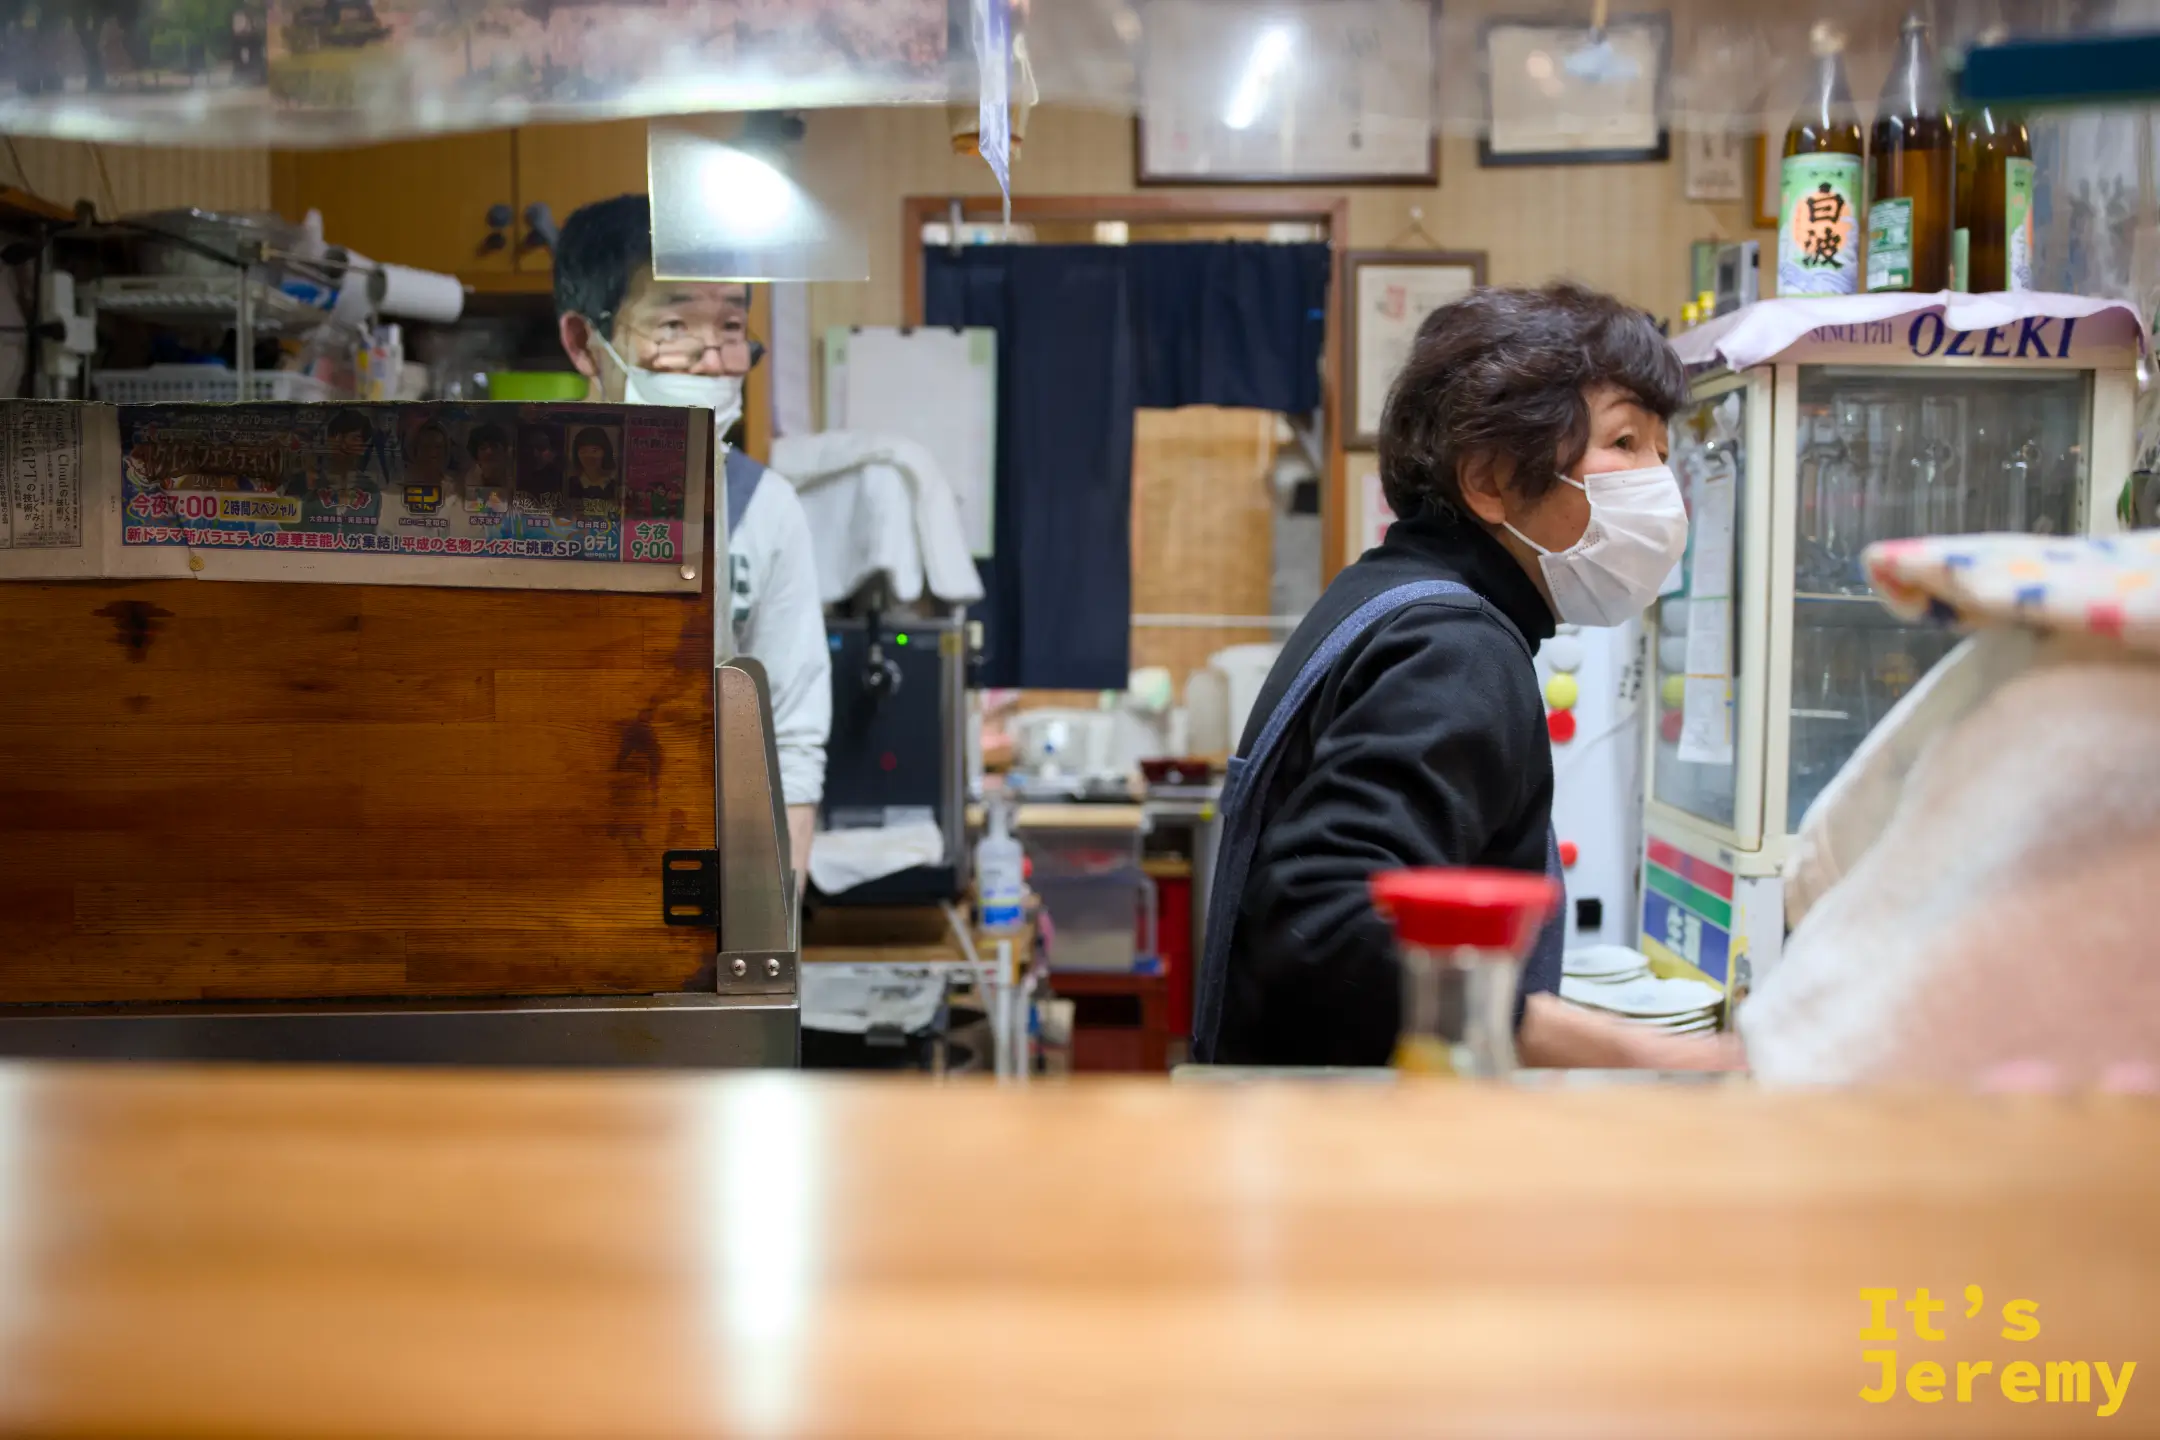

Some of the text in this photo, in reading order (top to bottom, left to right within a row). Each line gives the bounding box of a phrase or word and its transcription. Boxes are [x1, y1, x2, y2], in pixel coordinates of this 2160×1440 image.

[1803, 182, 1845, 269] 白波
[1908, 312, 2079, 359] OZEKI
[223, 500, 297, 517] 2時間スペシャル
[636, 523, 669, 540] 今夜
[584, 535, 618, 551] 日テレ
[631, 540, 674, 561] 9:00
